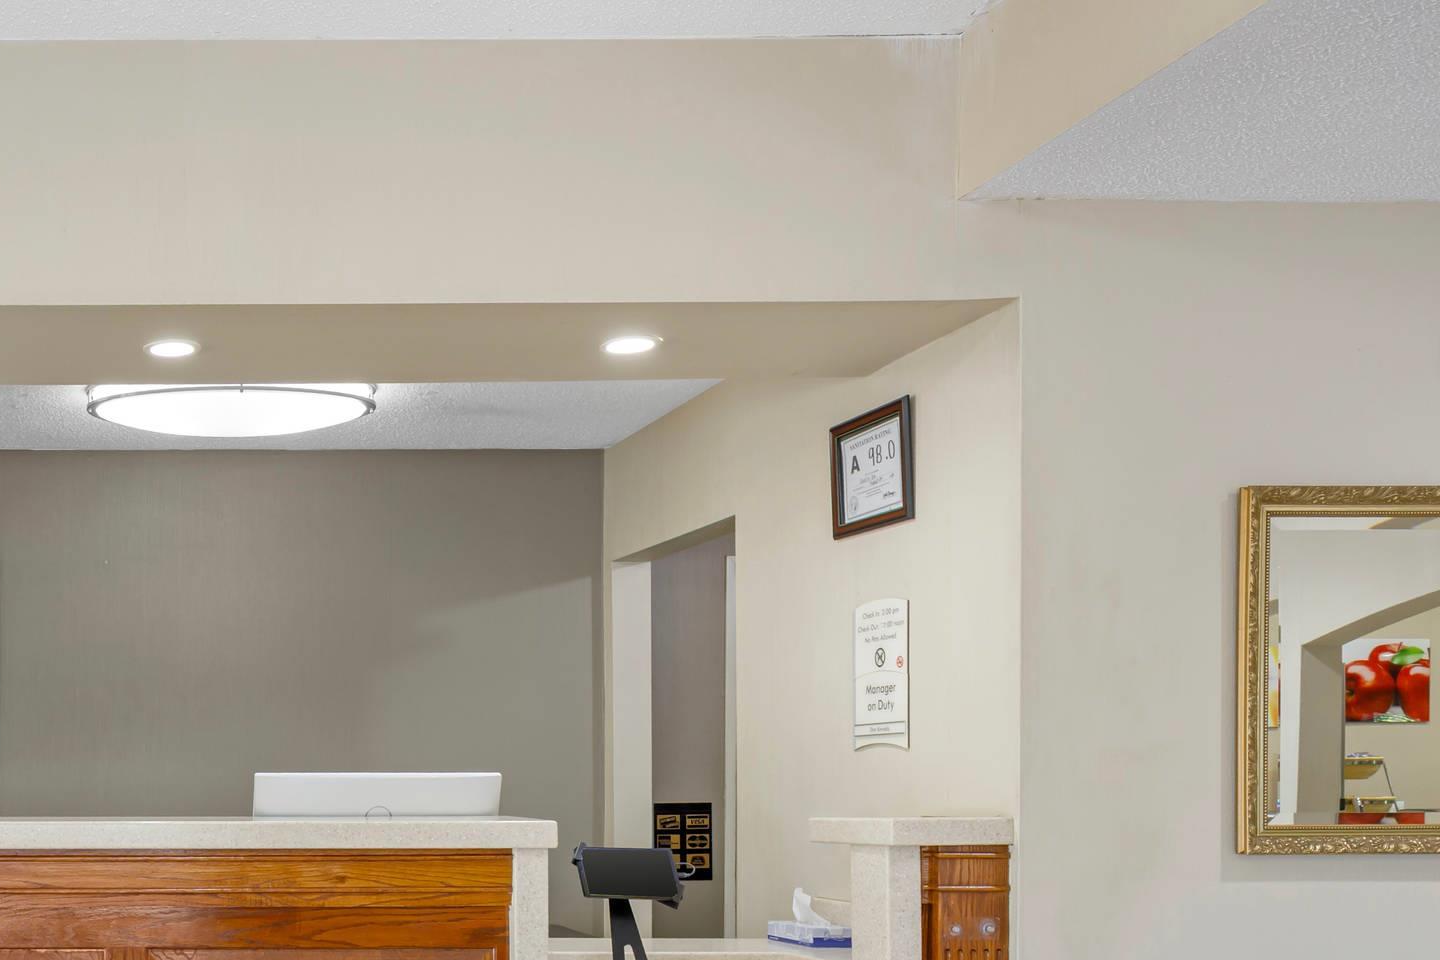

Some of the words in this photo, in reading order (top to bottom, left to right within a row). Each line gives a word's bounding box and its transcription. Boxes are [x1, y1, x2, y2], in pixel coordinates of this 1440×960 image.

[868, 439, 896, 467] 98.0
[850, 455, 861, 475] A
[865, 684, 896, 697] Manager
[867, 703, 877, 712] on
[877, 699, 895, 713] Duty
